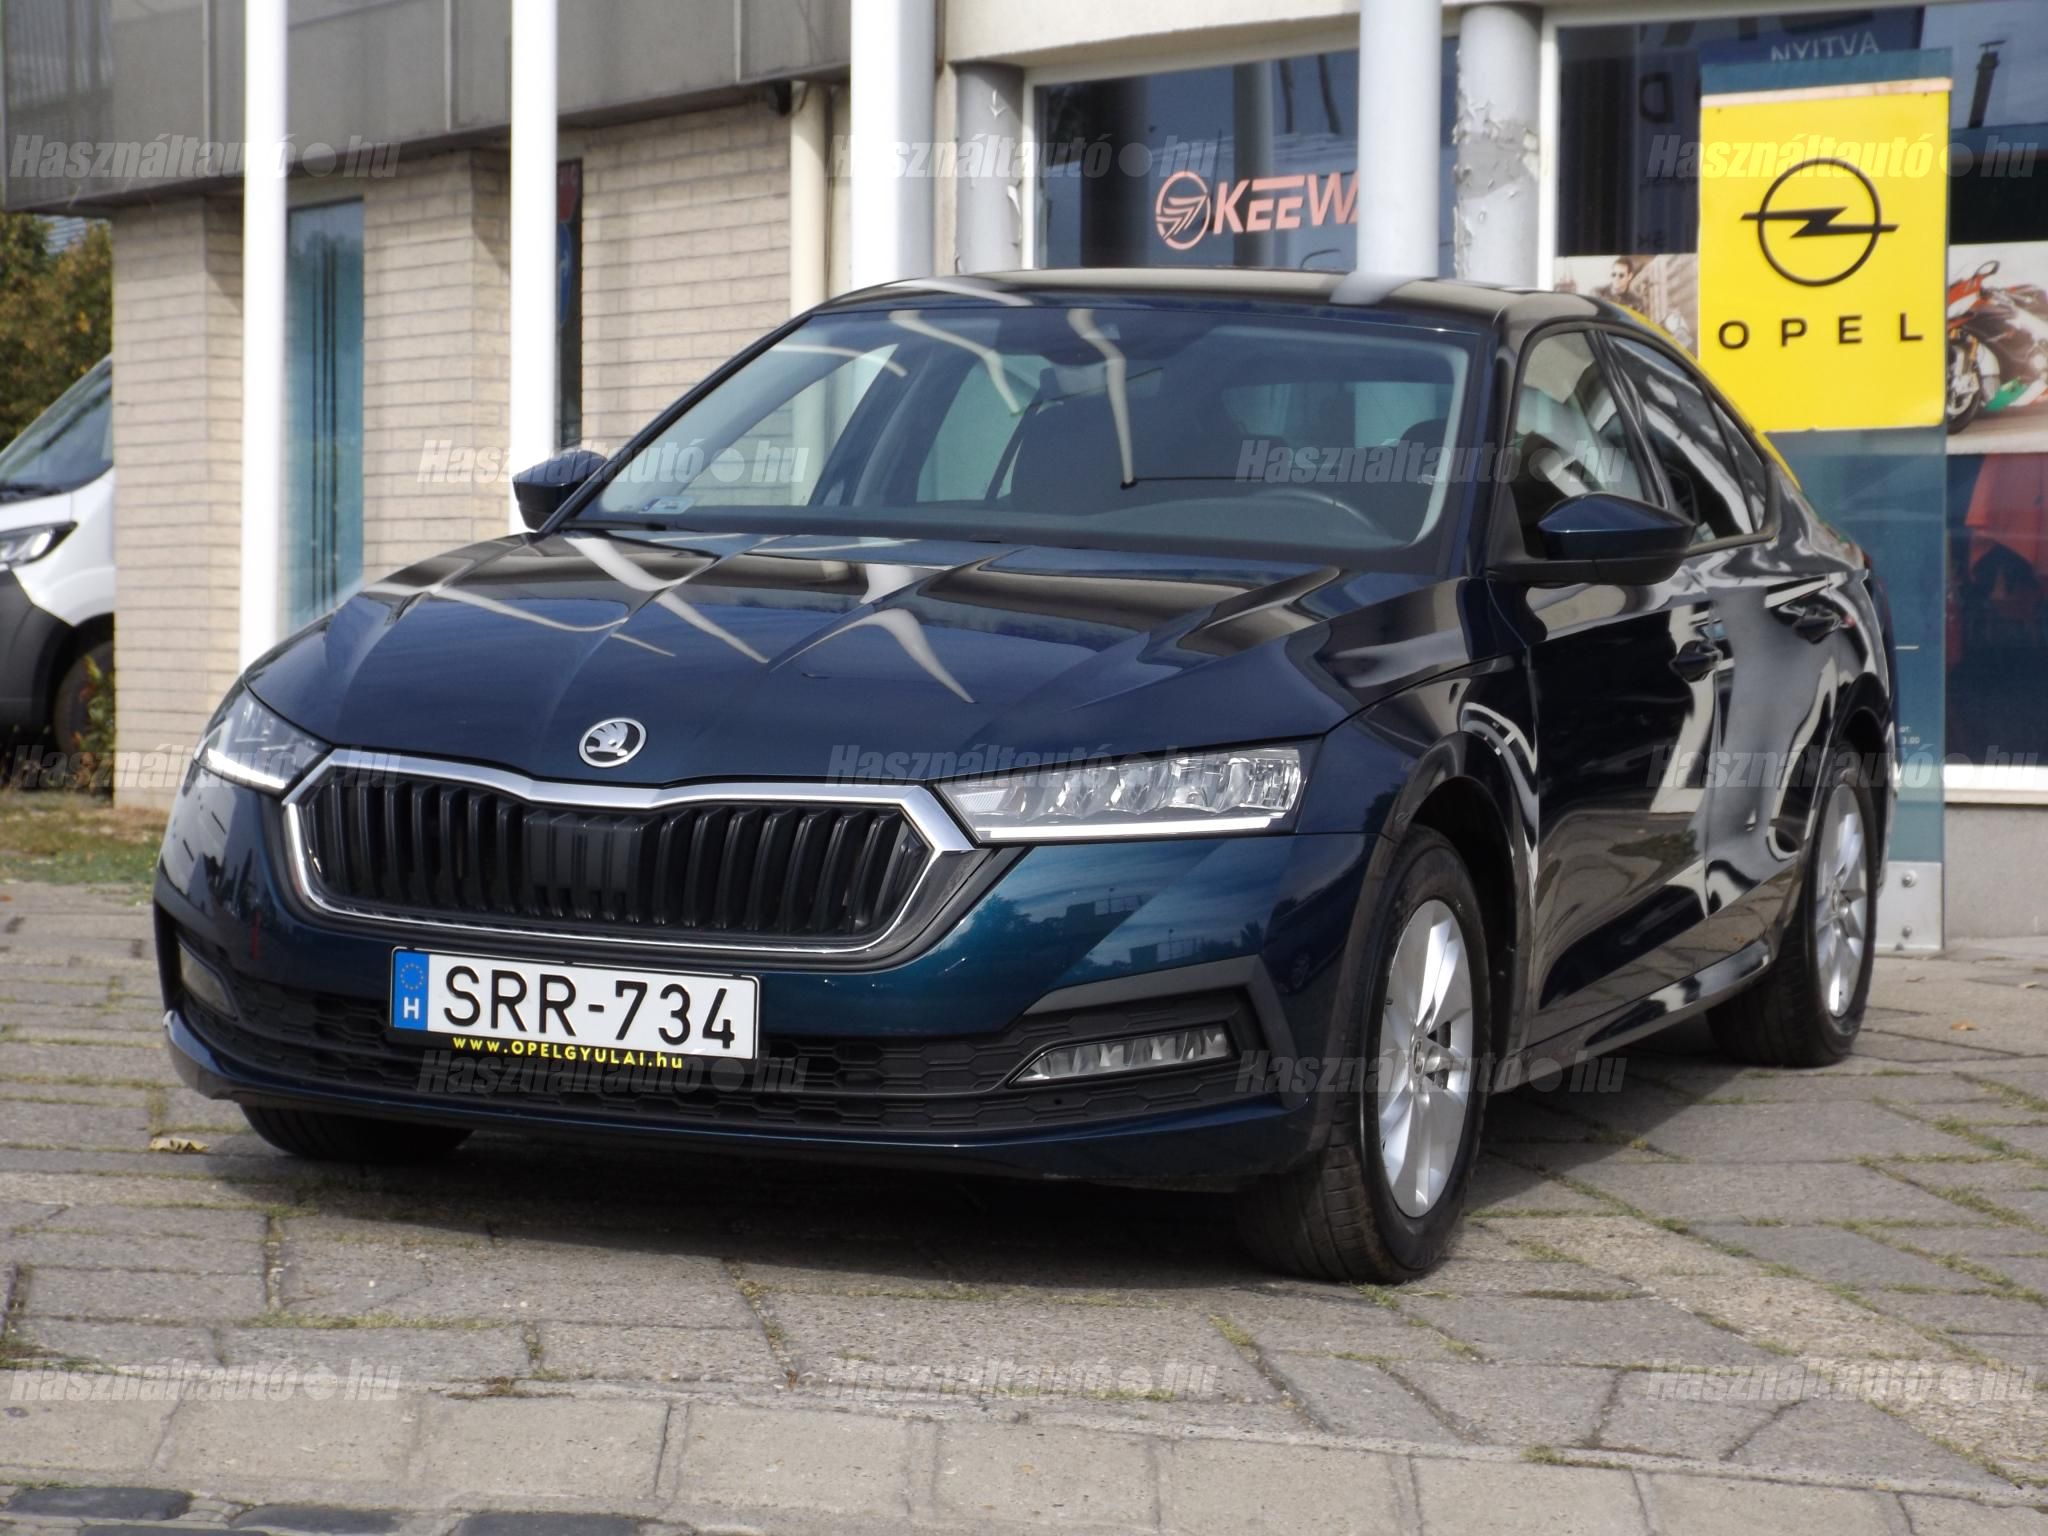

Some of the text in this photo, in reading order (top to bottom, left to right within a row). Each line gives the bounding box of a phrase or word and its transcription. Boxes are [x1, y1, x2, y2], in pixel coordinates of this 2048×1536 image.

[1770, 31, 1880, 62] NYITVA
[1717, 312, 1924, 350] OPEL
[403, 965, 735, 1049] H SRR-734
